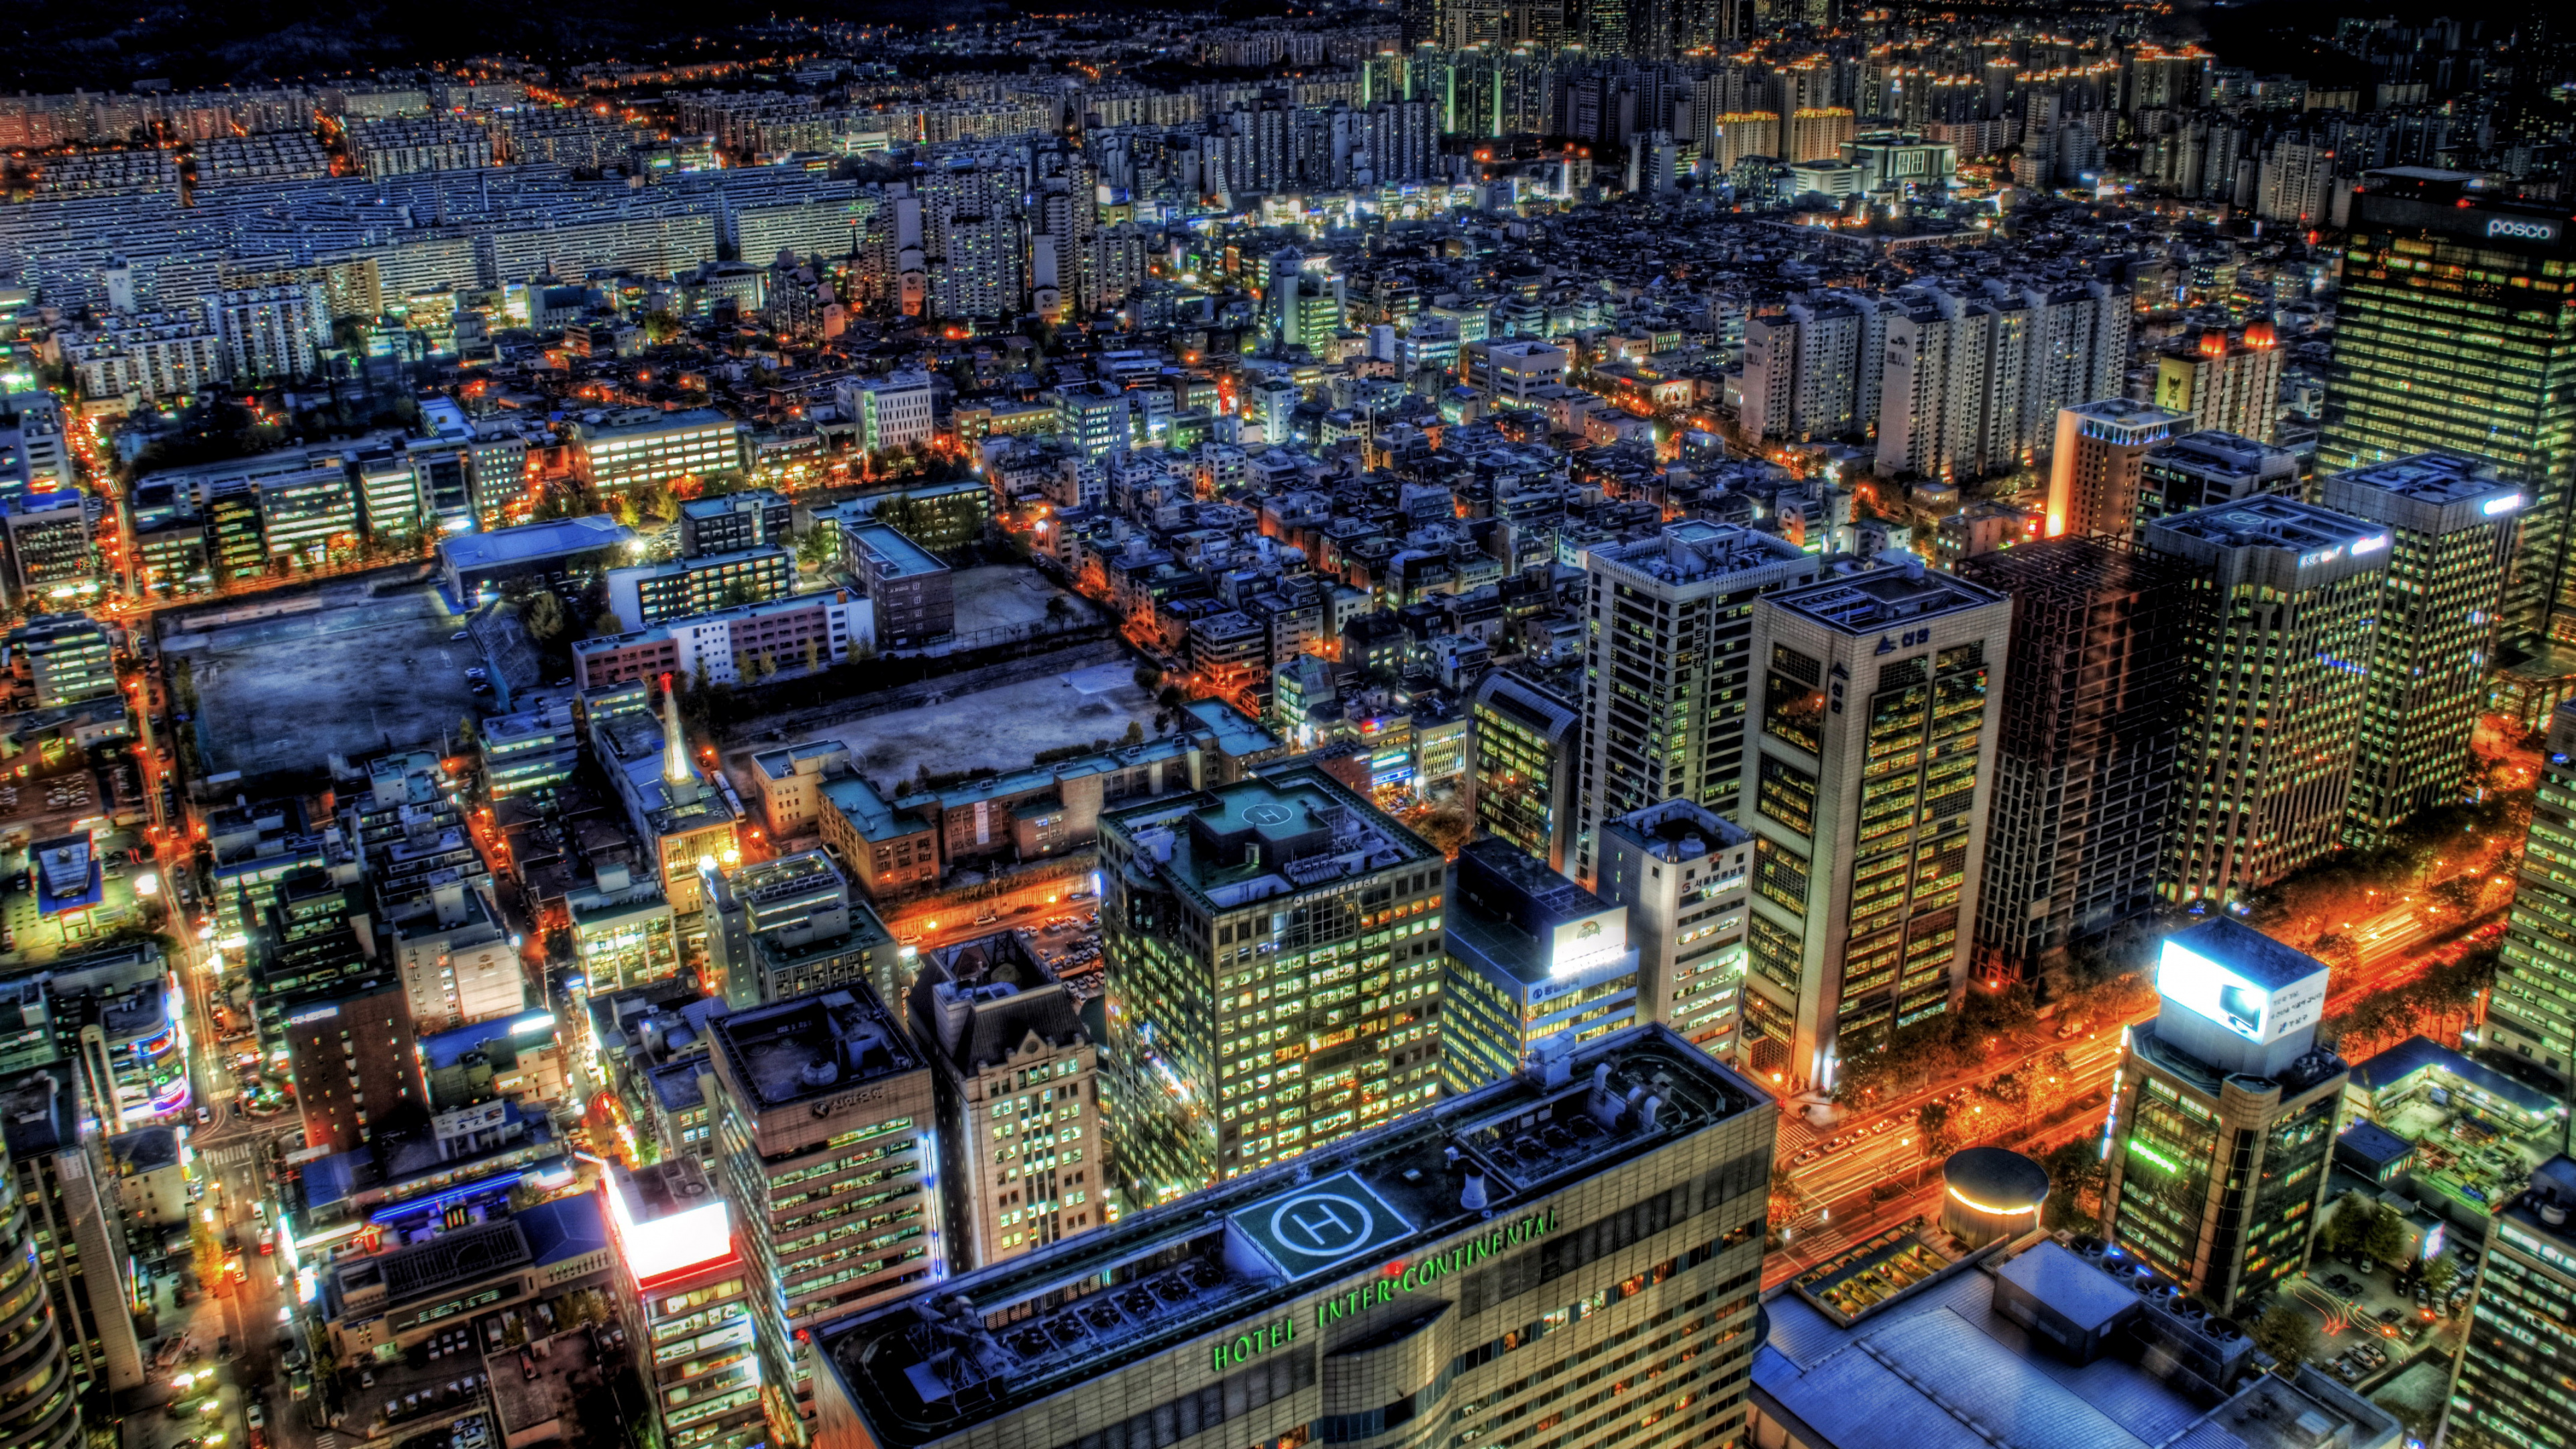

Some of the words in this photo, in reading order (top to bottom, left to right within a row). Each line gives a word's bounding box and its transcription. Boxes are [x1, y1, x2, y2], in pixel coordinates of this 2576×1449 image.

[2487, 219, 2552, 240] posco
[1257, 809, 1281, 822] H
[1292, 1204, 1353, 1245] H
[1213, 1318, 1297, 1372] HOTEL
